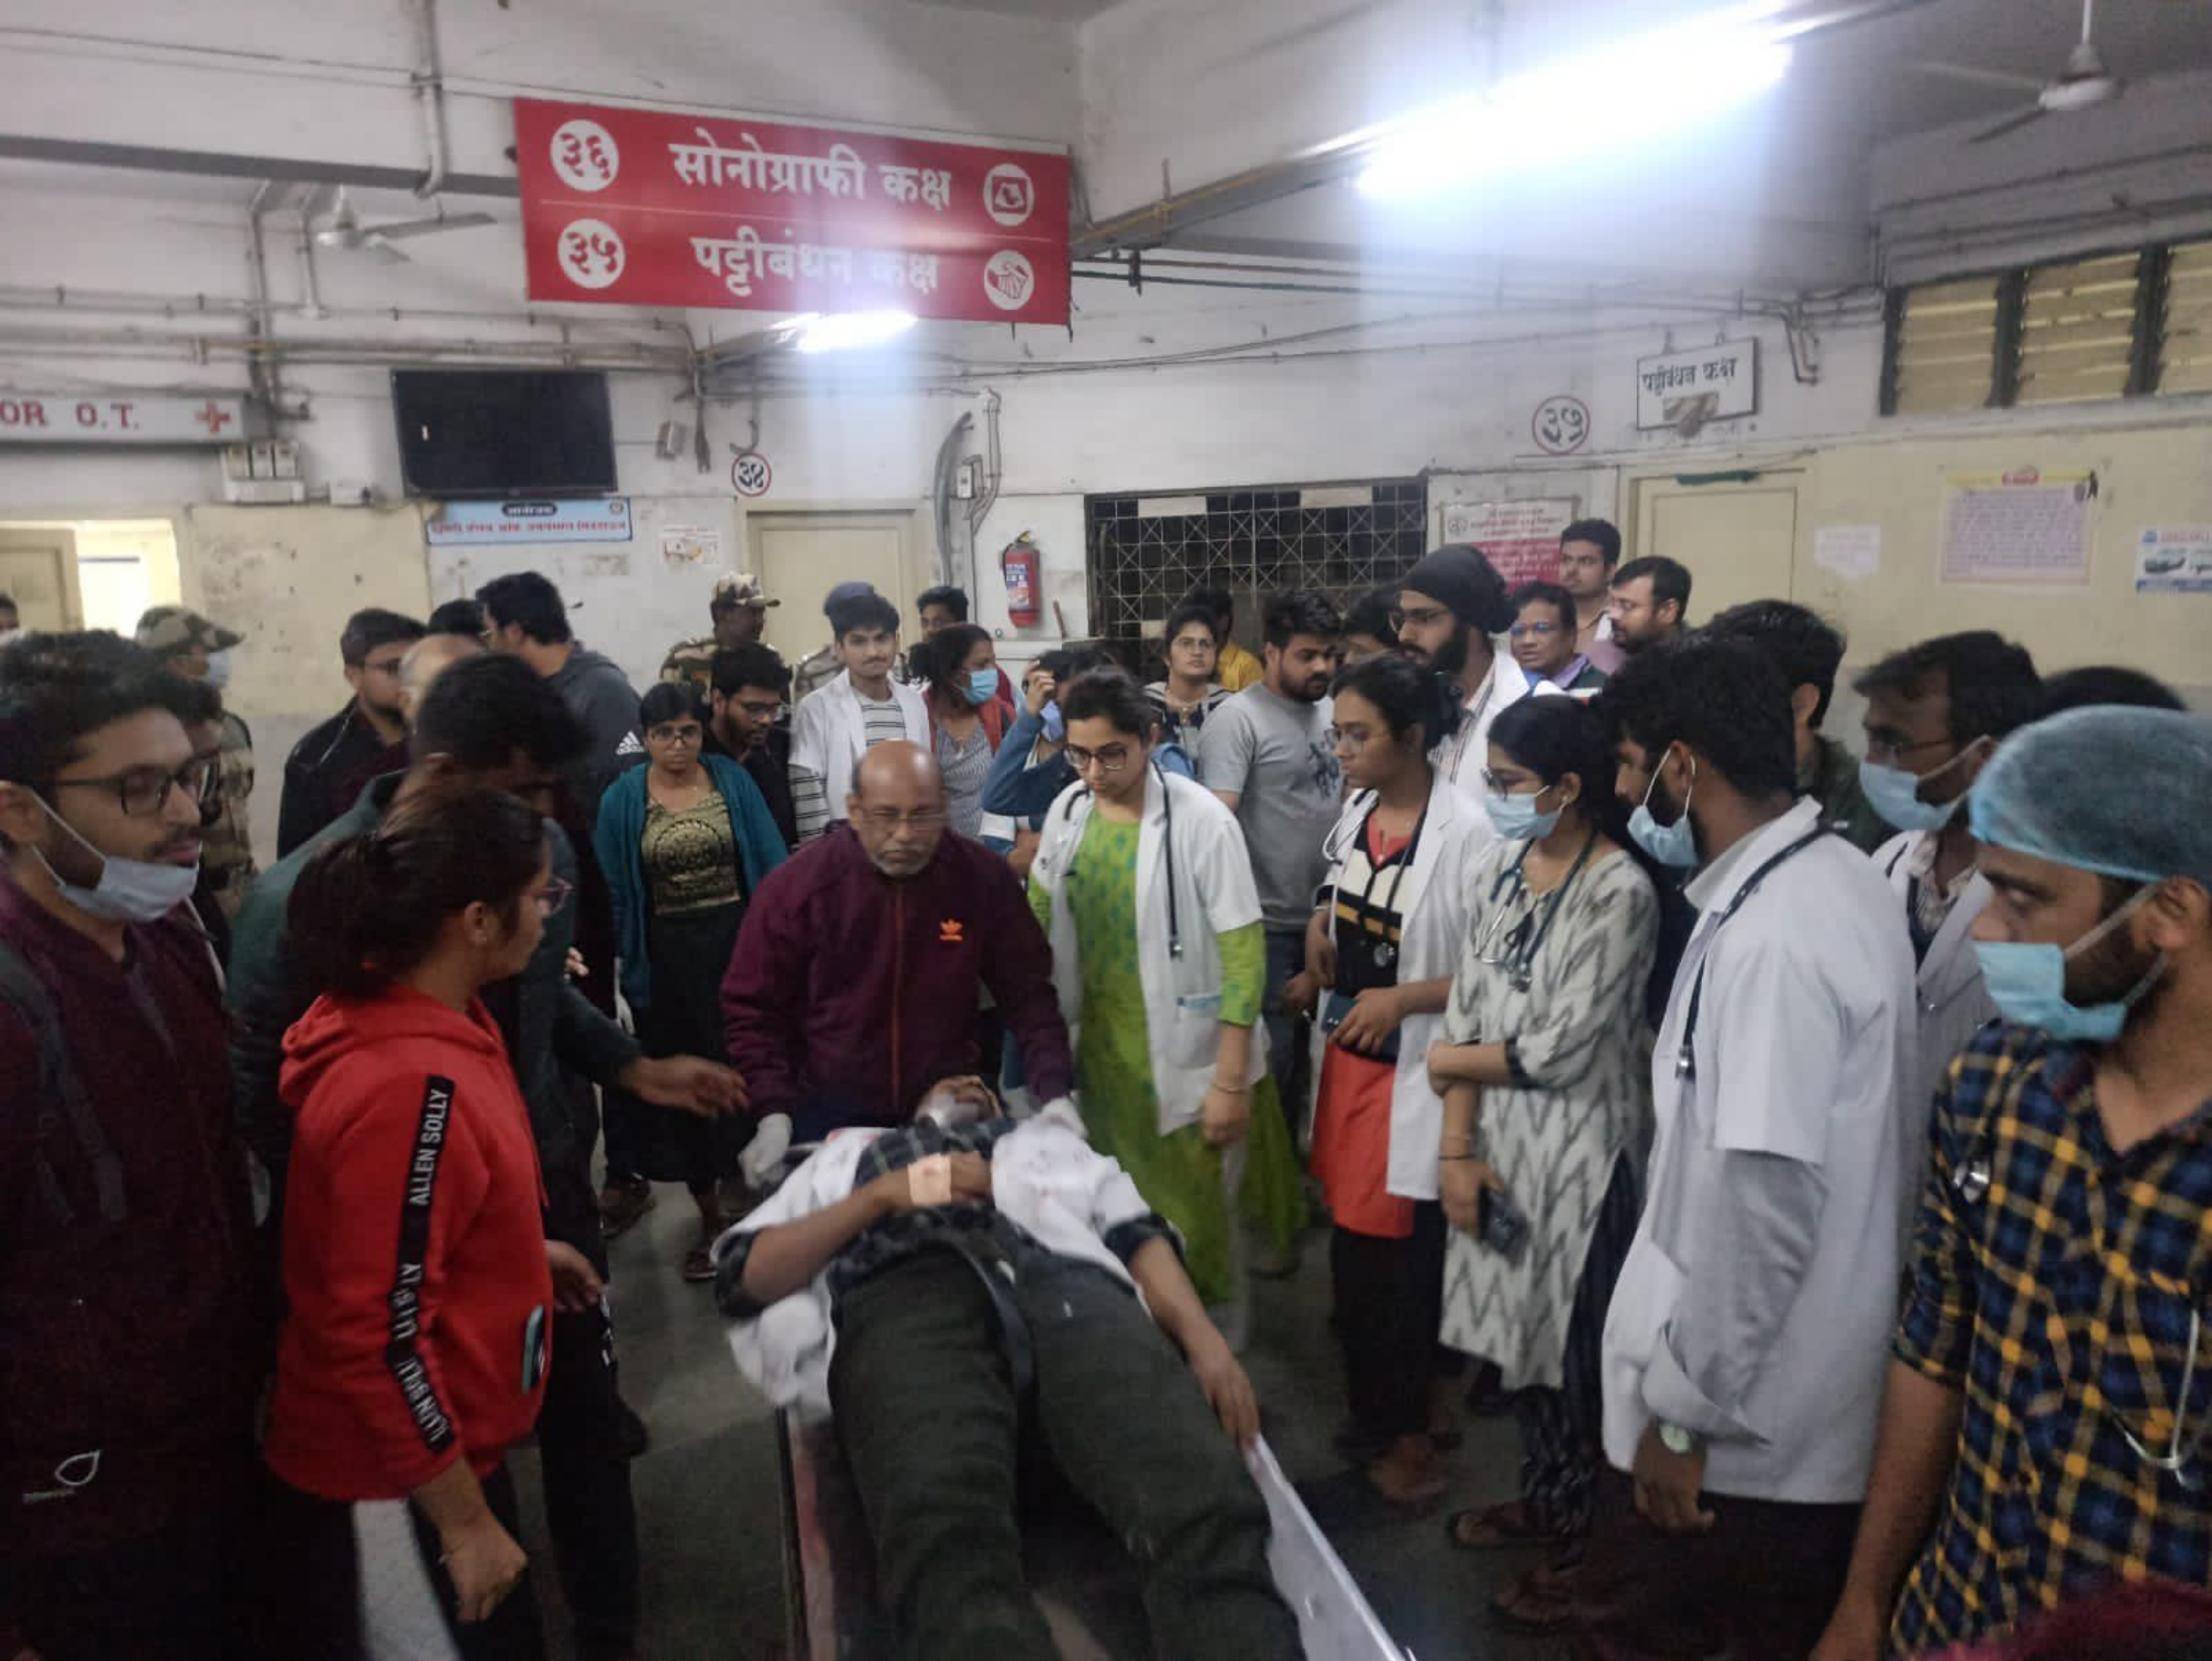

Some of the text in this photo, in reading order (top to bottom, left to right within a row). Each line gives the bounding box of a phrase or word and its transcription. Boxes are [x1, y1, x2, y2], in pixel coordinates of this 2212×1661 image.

[667, 126, 867, 200] सोनोग्राफी
[880, 164, 952, 211] कक्ष
[689, 224, 852, 296] पट्टीबंधन
[865, 248, 939, 294] कक्ष
[408, 1088, 450, 1206] ALLEN SOLLY
